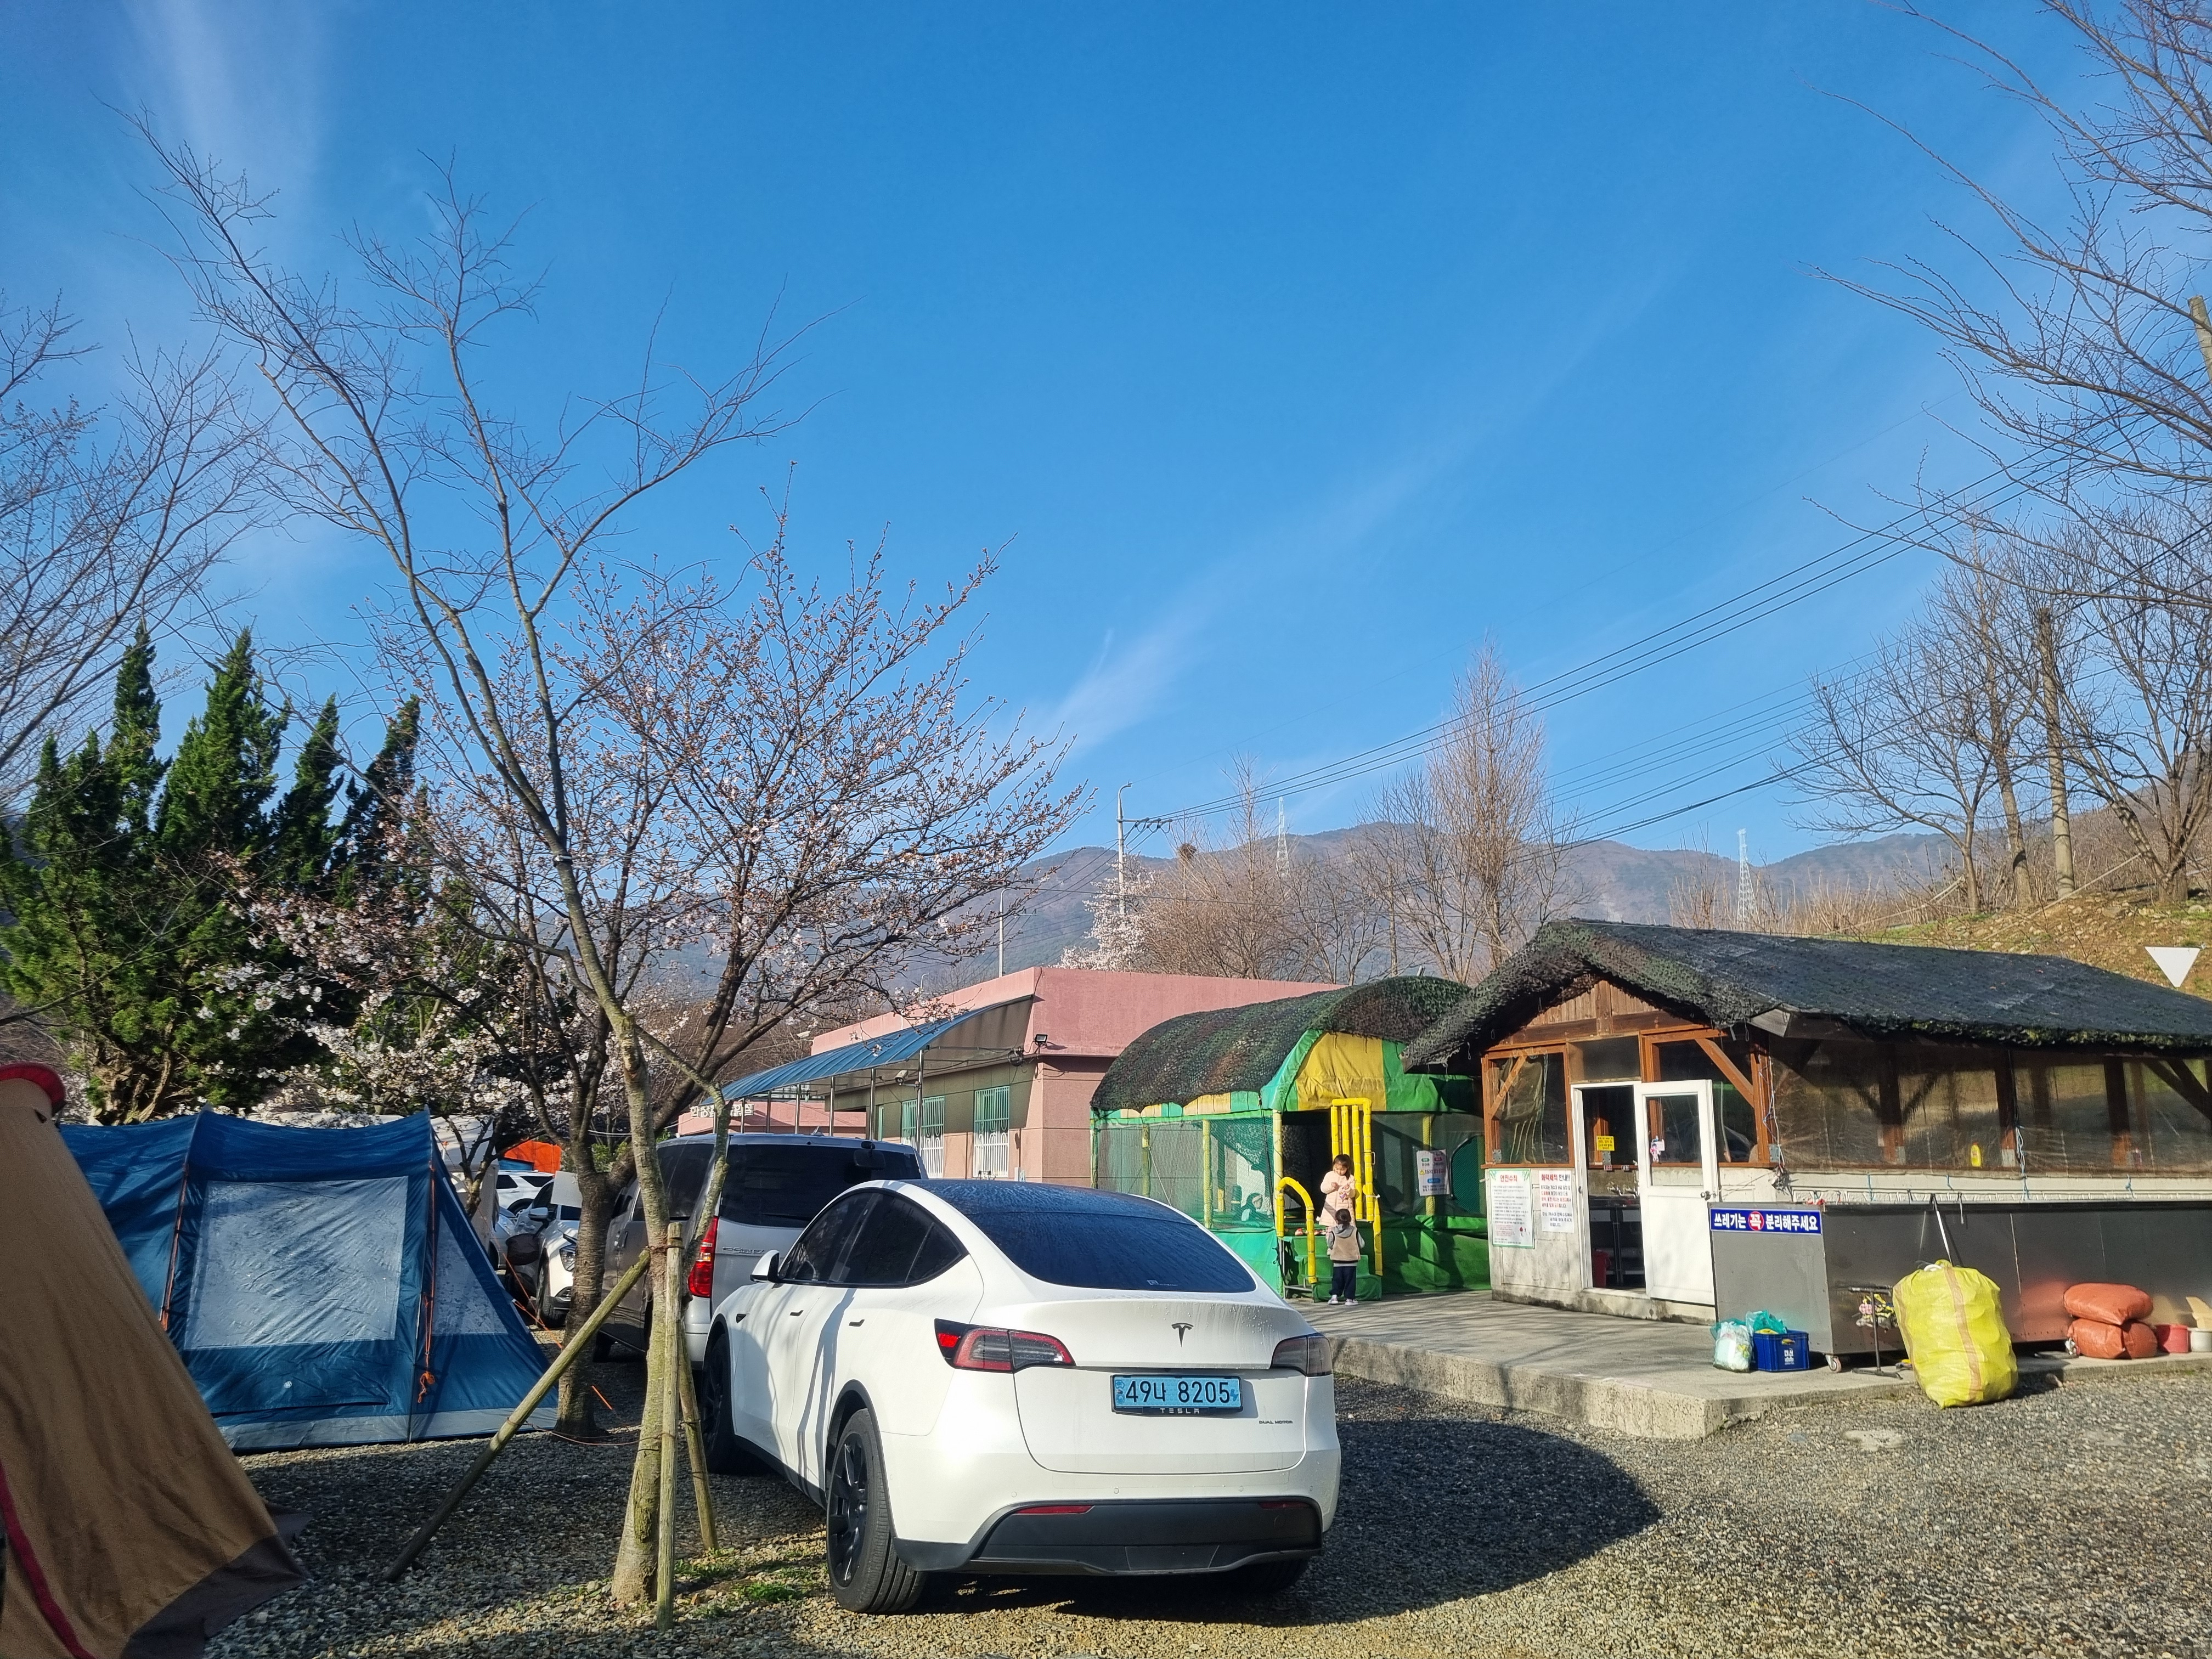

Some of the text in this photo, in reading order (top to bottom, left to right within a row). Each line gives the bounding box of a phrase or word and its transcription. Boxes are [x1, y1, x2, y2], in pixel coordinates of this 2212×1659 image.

[1714, 1213, 1818, 1231] 쓰레기는 꼭 분리해주세요
[1125, 1381, 1230, 1403] 49나 8205
